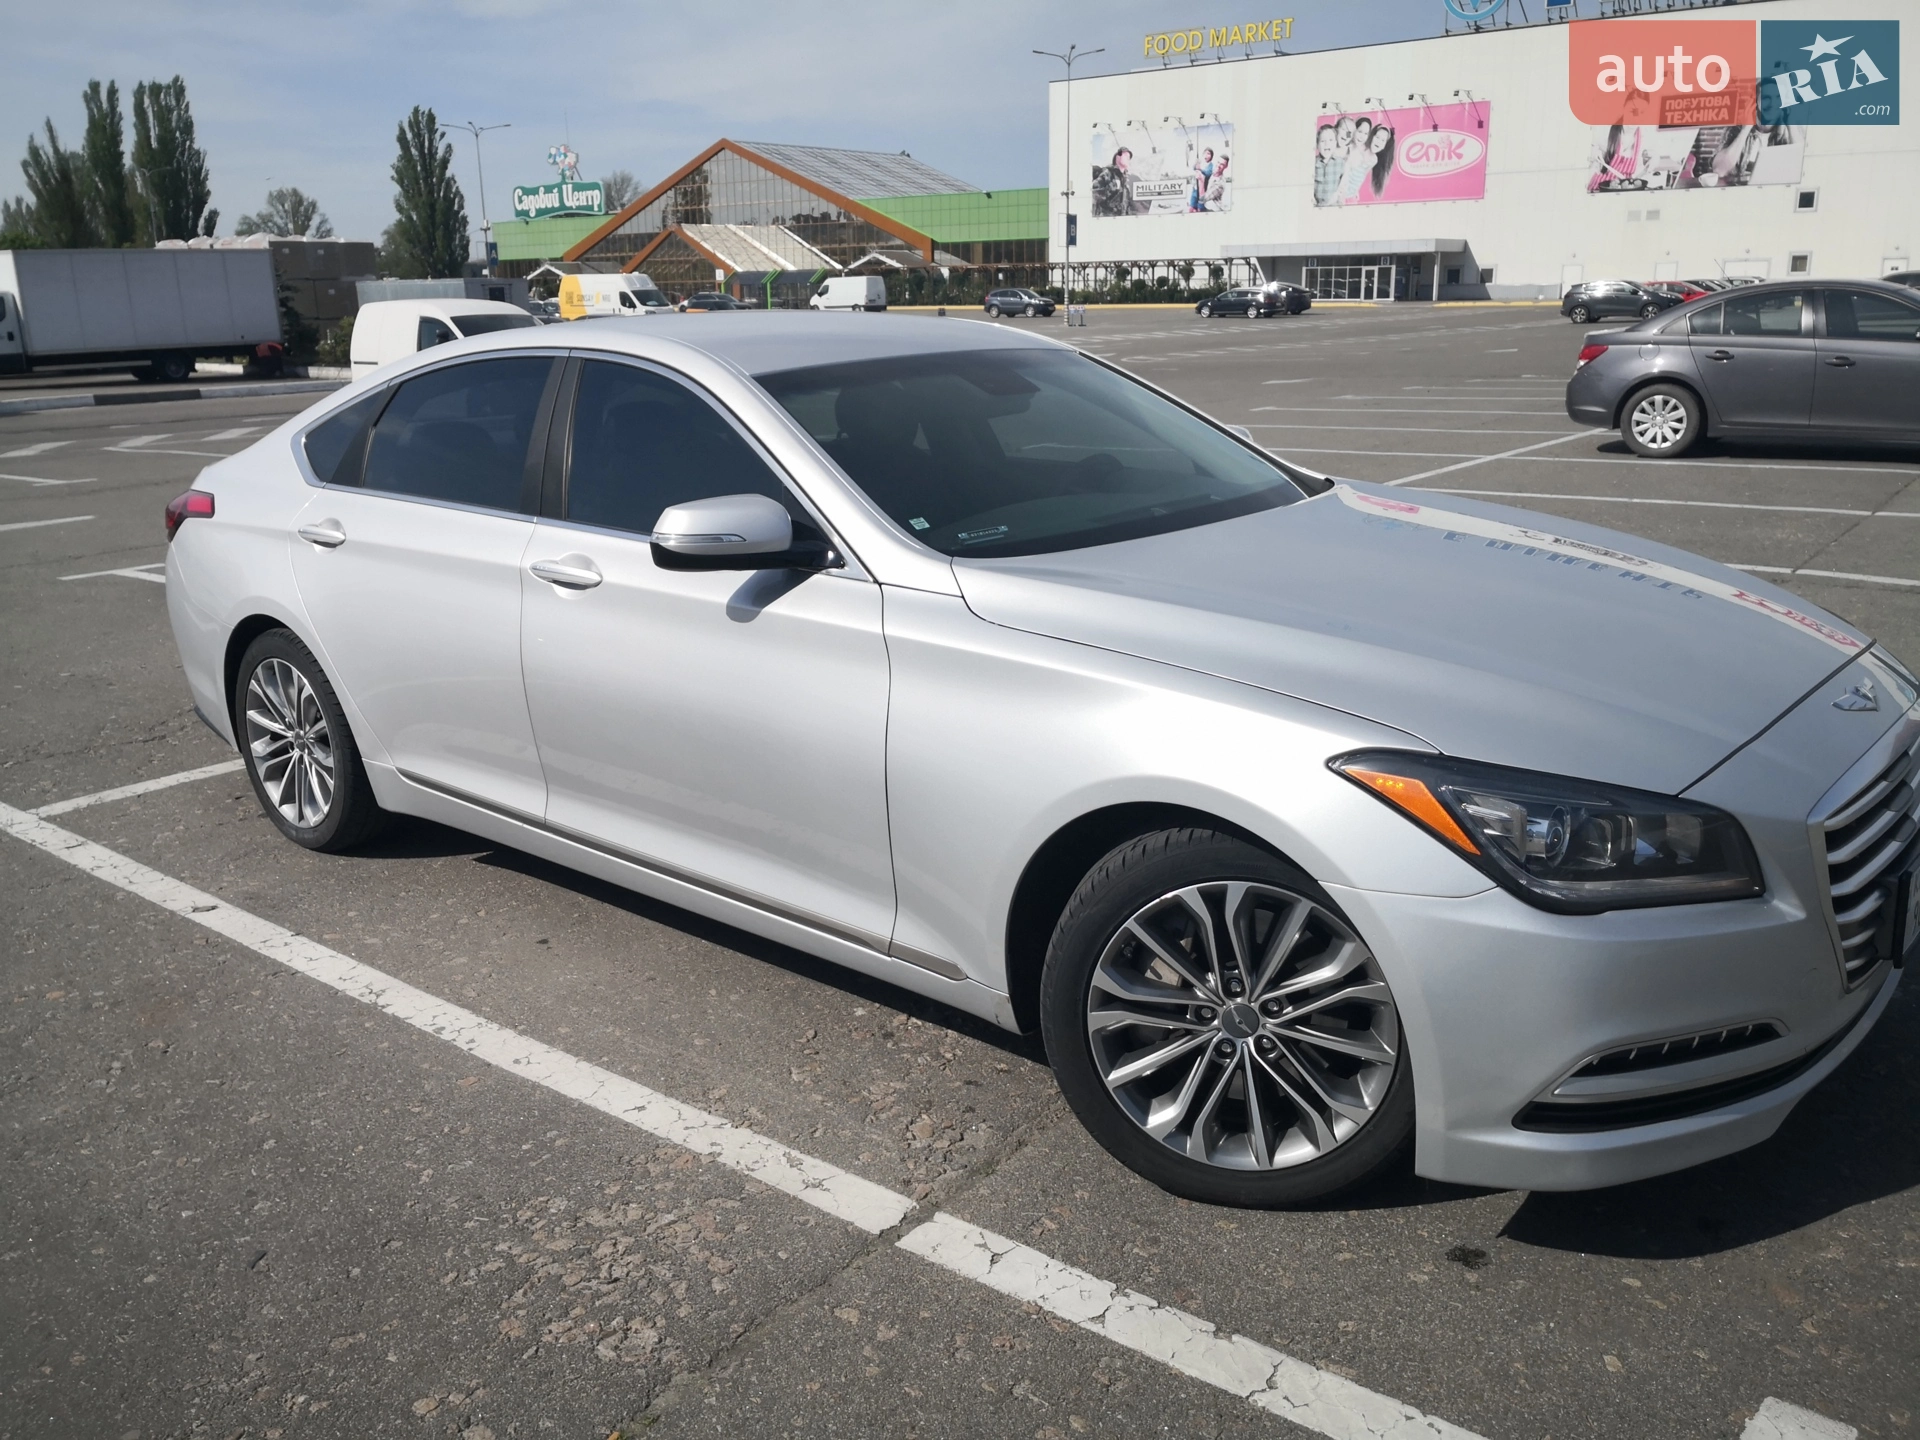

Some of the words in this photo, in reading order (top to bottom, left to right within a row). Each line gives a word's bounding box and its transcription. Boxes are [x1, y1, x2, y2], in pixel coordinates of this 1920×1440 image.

[1144, 30, 1203, 56] FOOD
[1209, 17, 1294, 48] MARKET
[1665, 95, 1731, 111] ПОБУТОВА
[1665, 107, 1730, 124] ТЕХНІКА
[1135, 182, 1183, 192] MILITARY
[514, 187, 560, 217] Садовий
[561, 183, 601, 211] Центр
